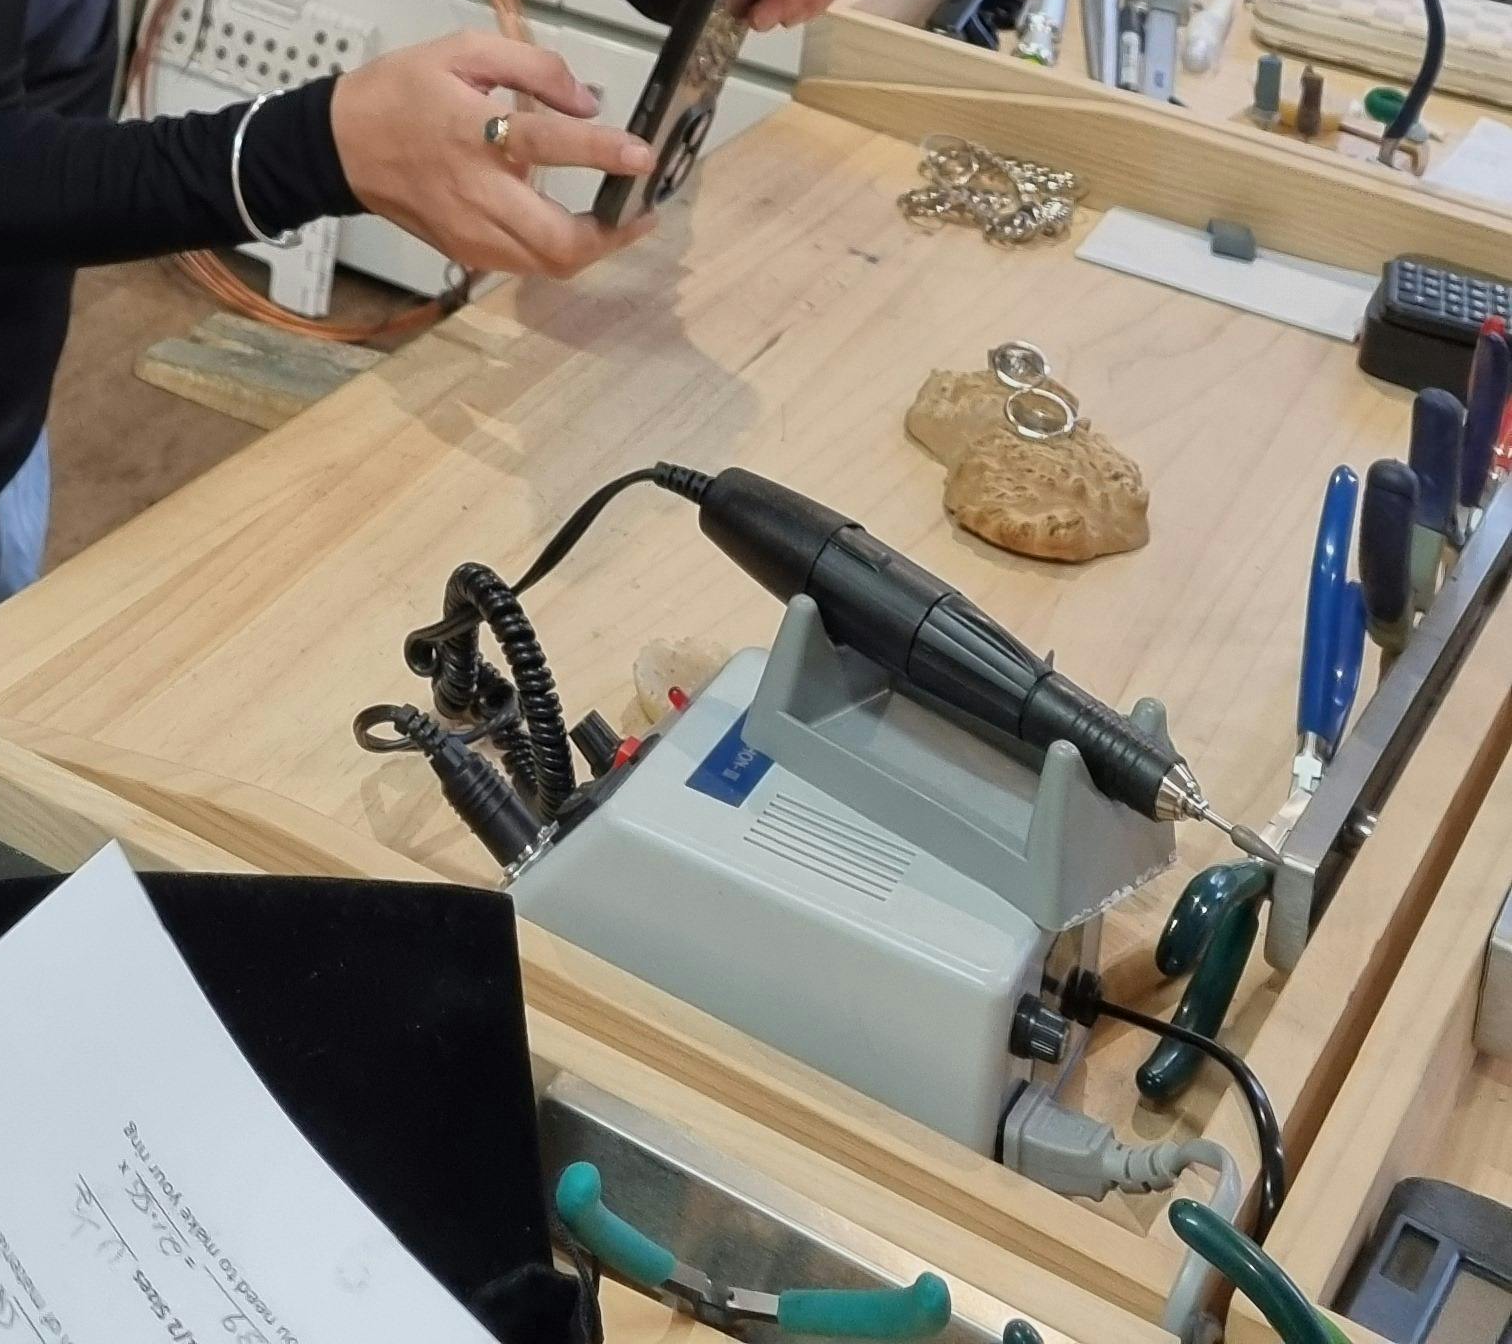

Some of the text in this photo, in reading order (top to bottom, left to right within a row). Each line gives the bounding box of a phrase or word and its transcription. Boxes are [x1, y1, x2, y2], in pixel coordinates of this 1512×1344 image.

[123, 1120, 151, 1162] ring
[148, 1163, 183, 1207] your
[180, 1206, 220, 1258] make
[218, 1257, 238, 1282] to
[132, 1269, 171, 1320] Sizes
[234, 1277, 276, 1325] need
